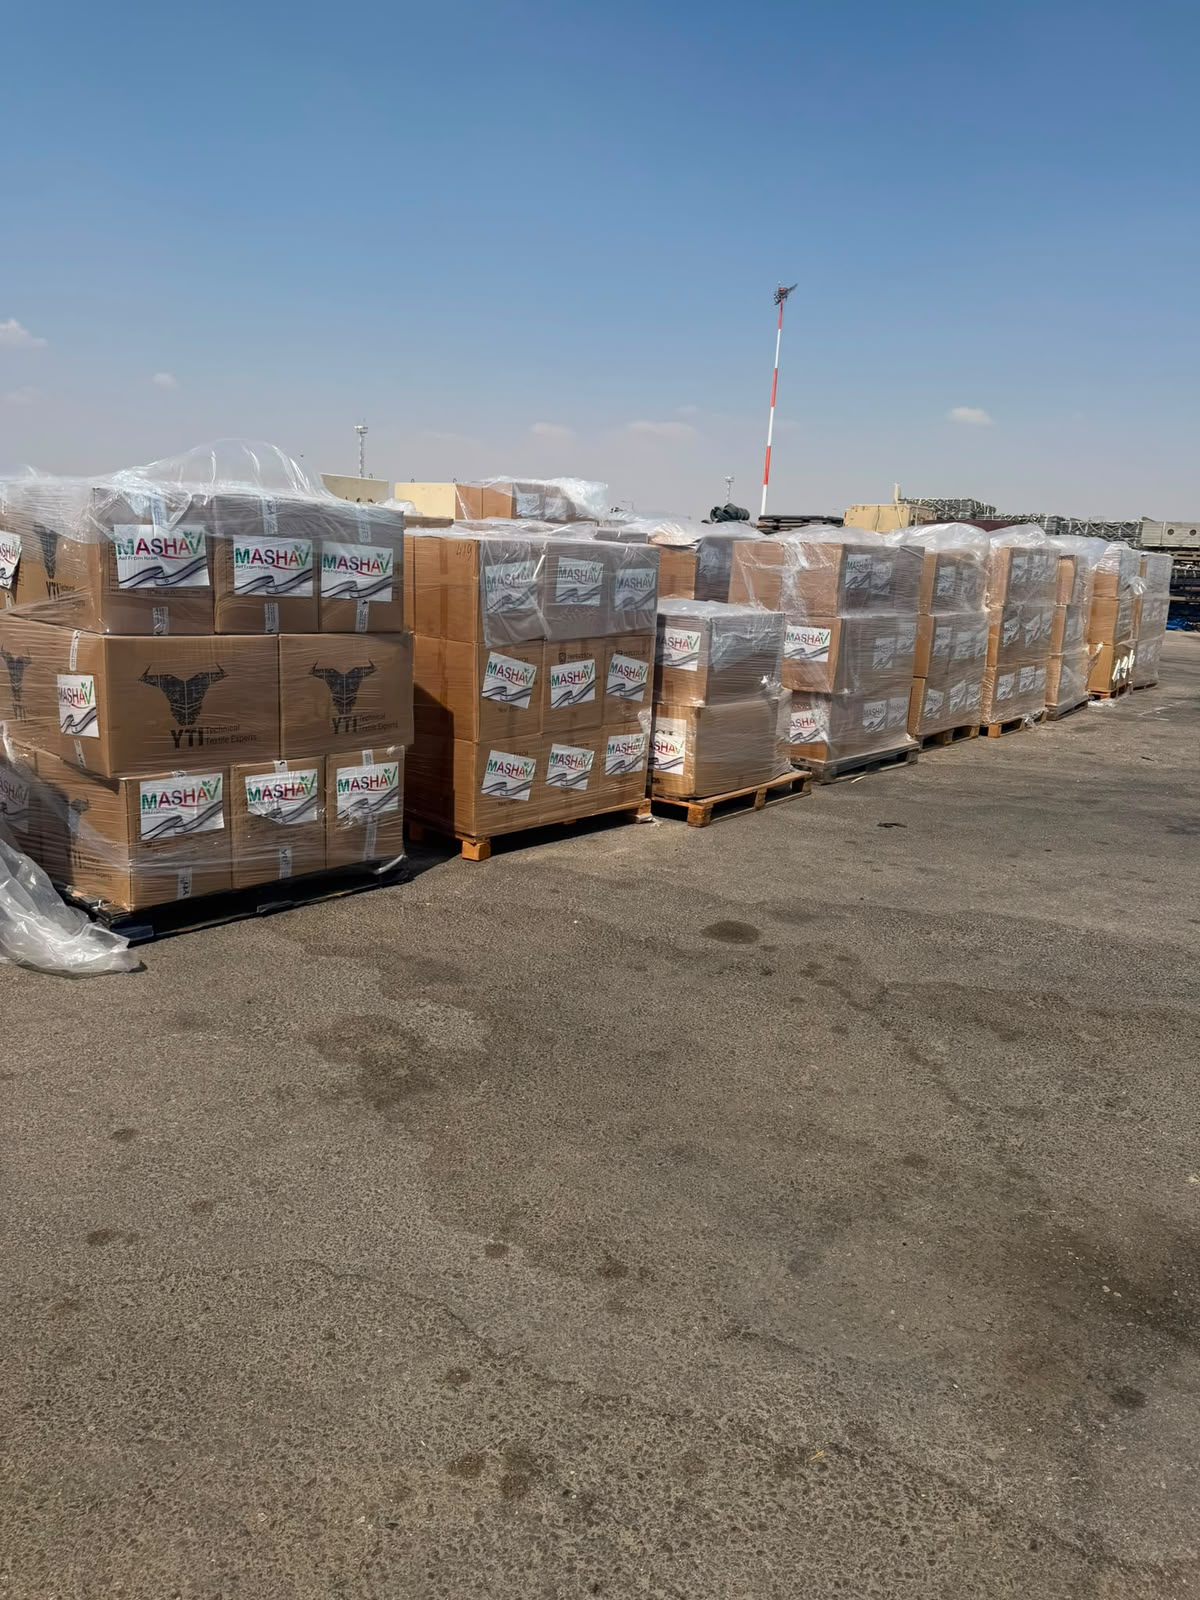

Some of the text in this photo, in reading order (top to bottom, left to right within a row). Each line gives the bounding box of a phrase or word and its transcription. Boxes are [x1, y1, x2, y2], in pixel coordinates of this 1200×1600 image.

[117, 531, 203, 556] MASHAV
[235, 544, 311, 567] MASHAV
[322, 553, 392, 574] MASHAV
[558, 566, 602, 584] MASHAV
[617, 572, 655, 589] MASHAV
[658, 634, 699, 650] ASHAV
[787, 631, 830, 645] MASHAV
[487, 661, 536, 685] MASHAV
[551, 662, 594, 687] MASHAV
[610, 662, 648, 681] MASHAV
[332, 716, 357, 735] YTI
[170, 728, 204, 749] YTI
[607, 737, 645, 755] MASHAV
[650, 740, 684, 755] ASHAV
[487, 759, 535, 778] MASHAV
[550, 752, 593, 769] MASHAV
[247, 773, 316, 802] MASHAV
[337, 766, 398, 793] MASHAV
[142, 777, 221, 810] MASHAV
